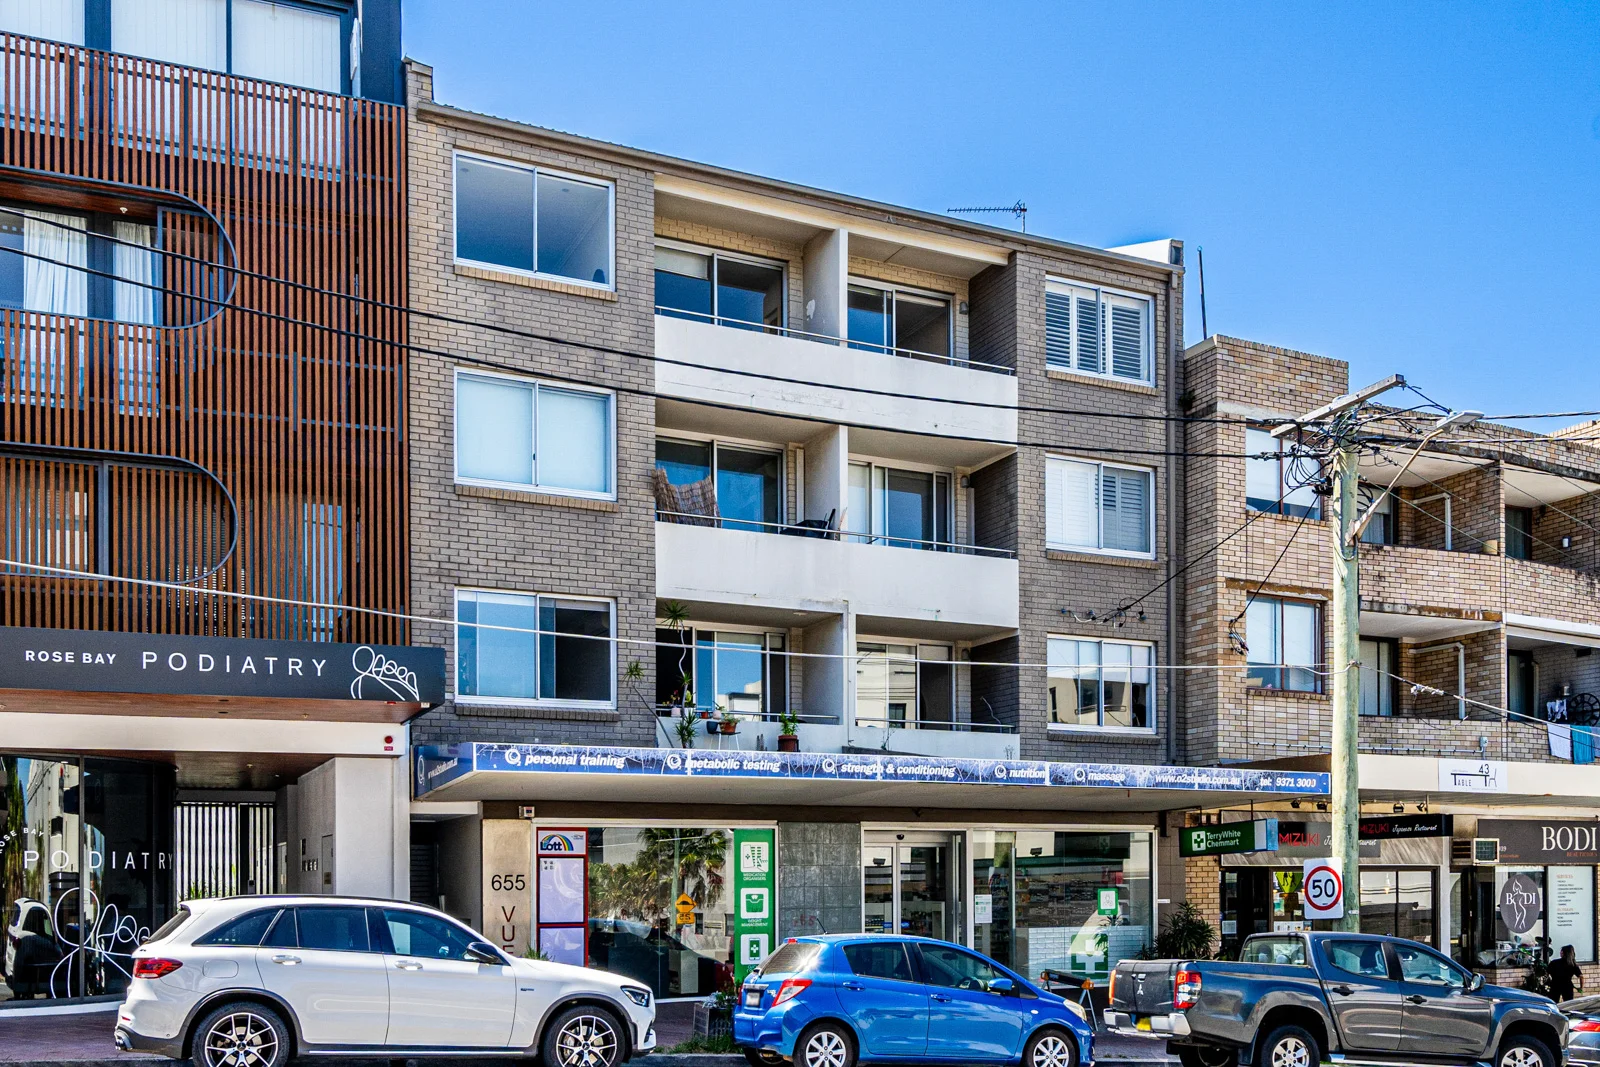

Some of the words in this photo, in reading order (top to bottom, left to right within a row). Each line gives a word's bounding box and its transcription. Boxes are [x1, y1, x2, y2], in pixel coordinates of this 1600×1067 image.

[25, 650, 75, 663] ROSE
[82, 652, 116, 664] BAY
[142, 651, 327, 677] PODIATRY
[525, 754, 577, 766] personal
[580, 754, 626, 769] training
[685, 758, 740, 770] metabolic
[743, 760, 781, 773] testing
[1478, 763, 1490, 774] 43
[840, 762, 884, 775] strength
[886, 764, 895, 774] &
[897, 765, 956, 778] conditioning
[1009, 768, 1045, 779] nutrition
[1088, 772, 1126, 783] massage
[1276, 777, 1295, 788] 9371
[0, 829, 18, 854] OSE
[23, 827, 44, 837] BAY
[1206, 830, 1242, 840] TerryWhite
[1278, 833, 1320, 847] MIZUKI
[1541, 826, 1598, 851] BODI
[1206, 838, 1240, 848] Chemmart
[23, 850, 173, 870] PODIATRY
[491, 874, 526, 891] 655
[1312, 878, 1335, 898] 50
